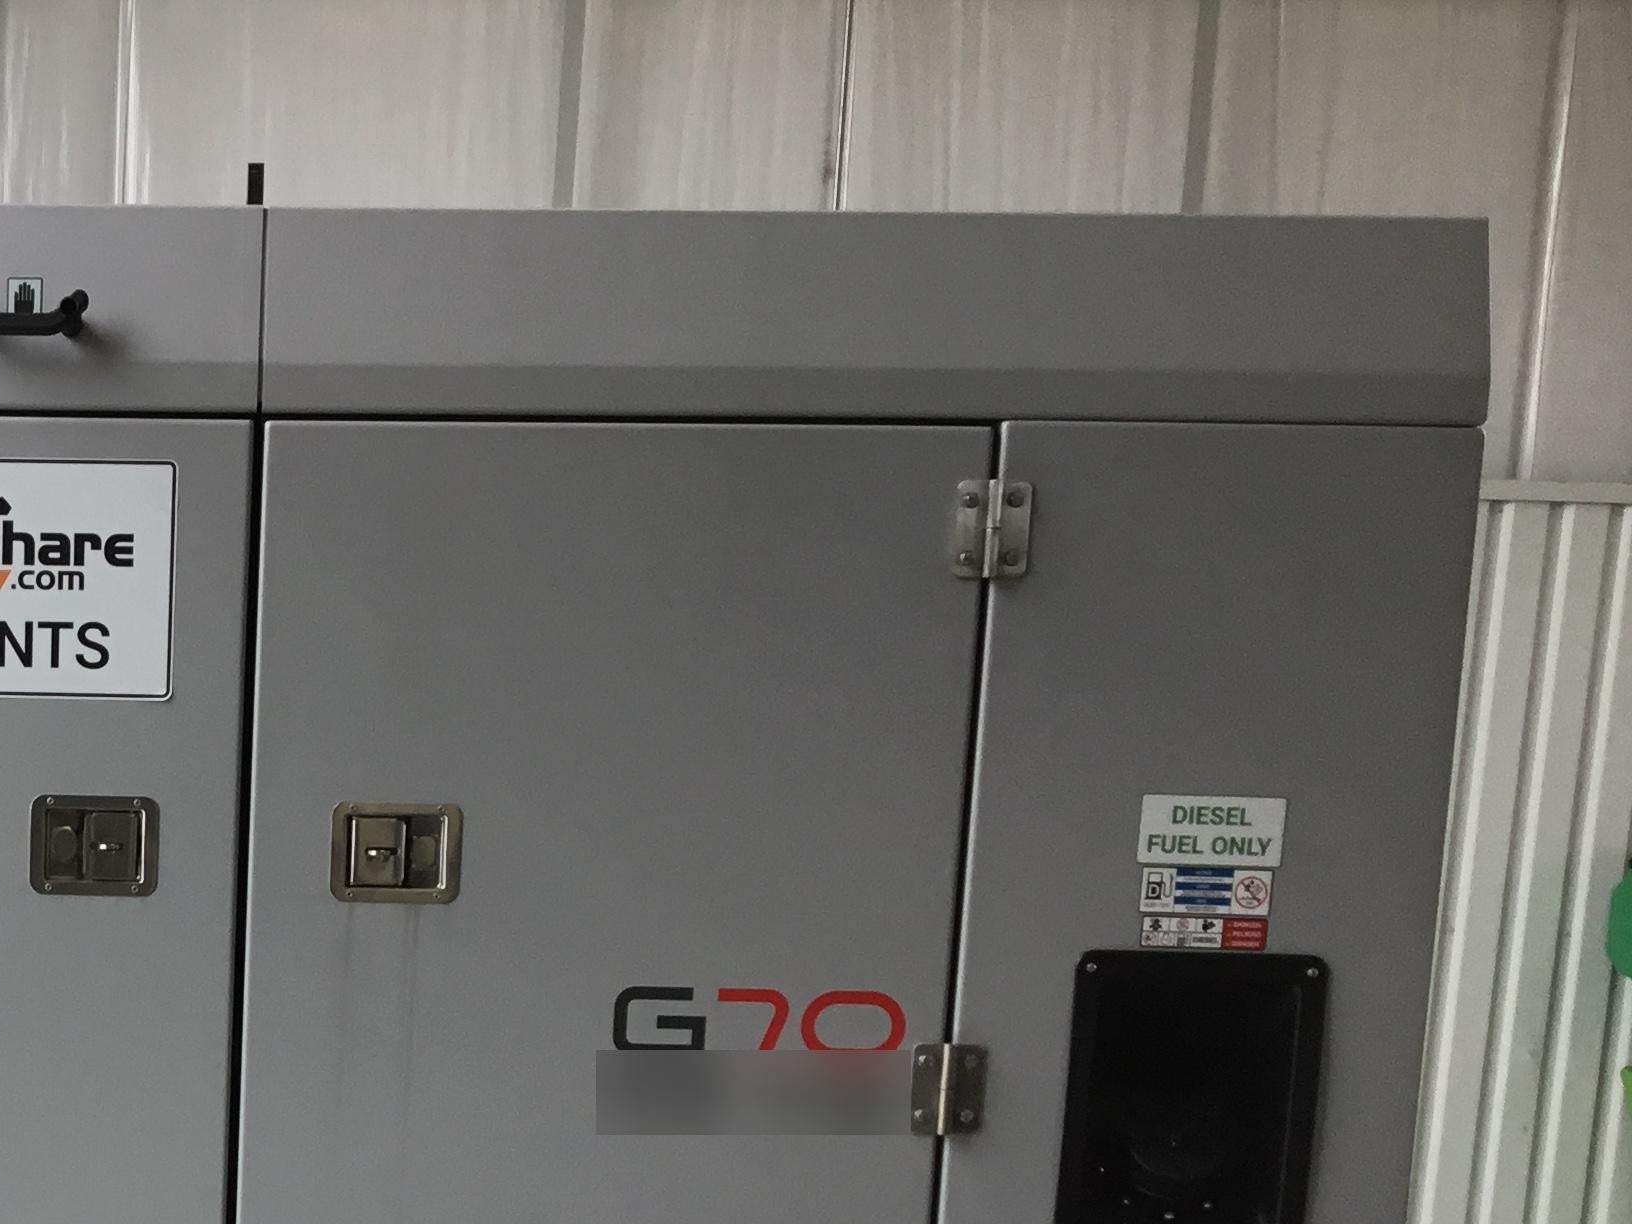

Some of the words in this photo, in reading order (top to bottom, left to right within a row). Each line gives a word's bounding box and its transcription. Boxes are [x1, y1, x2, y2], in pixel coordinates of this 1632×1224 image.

[10, 568, 85, 591] .com
[1171, 805, 1252, 827] DIESEL
[1146, 834, 1204, 855] FUEL
[1211, 836, 1272, 857] ONLY
[613, 985, 907, 1050] G70
